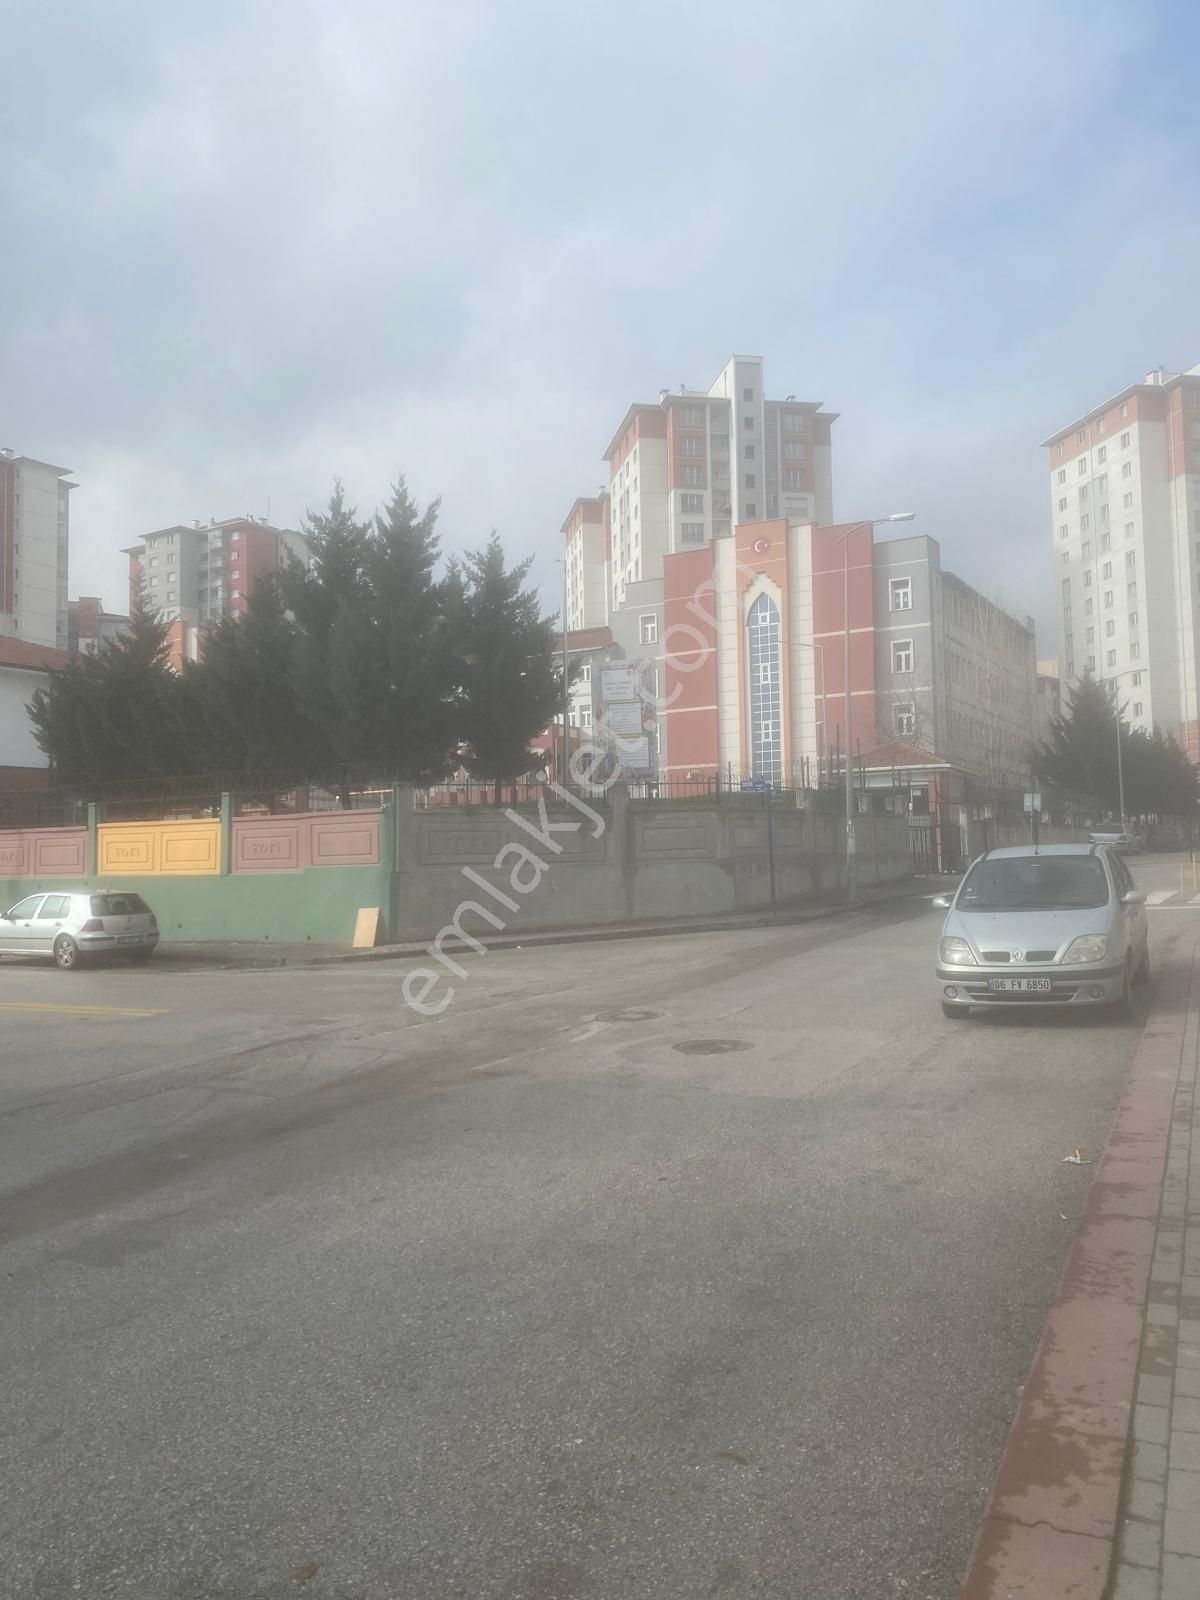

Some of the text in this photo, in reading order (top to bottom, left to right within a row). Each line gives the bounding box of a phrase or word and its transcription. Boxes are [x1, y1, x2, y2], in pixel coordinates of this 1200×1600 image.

[994, 979, 1049, 990] 06 FV 6850
